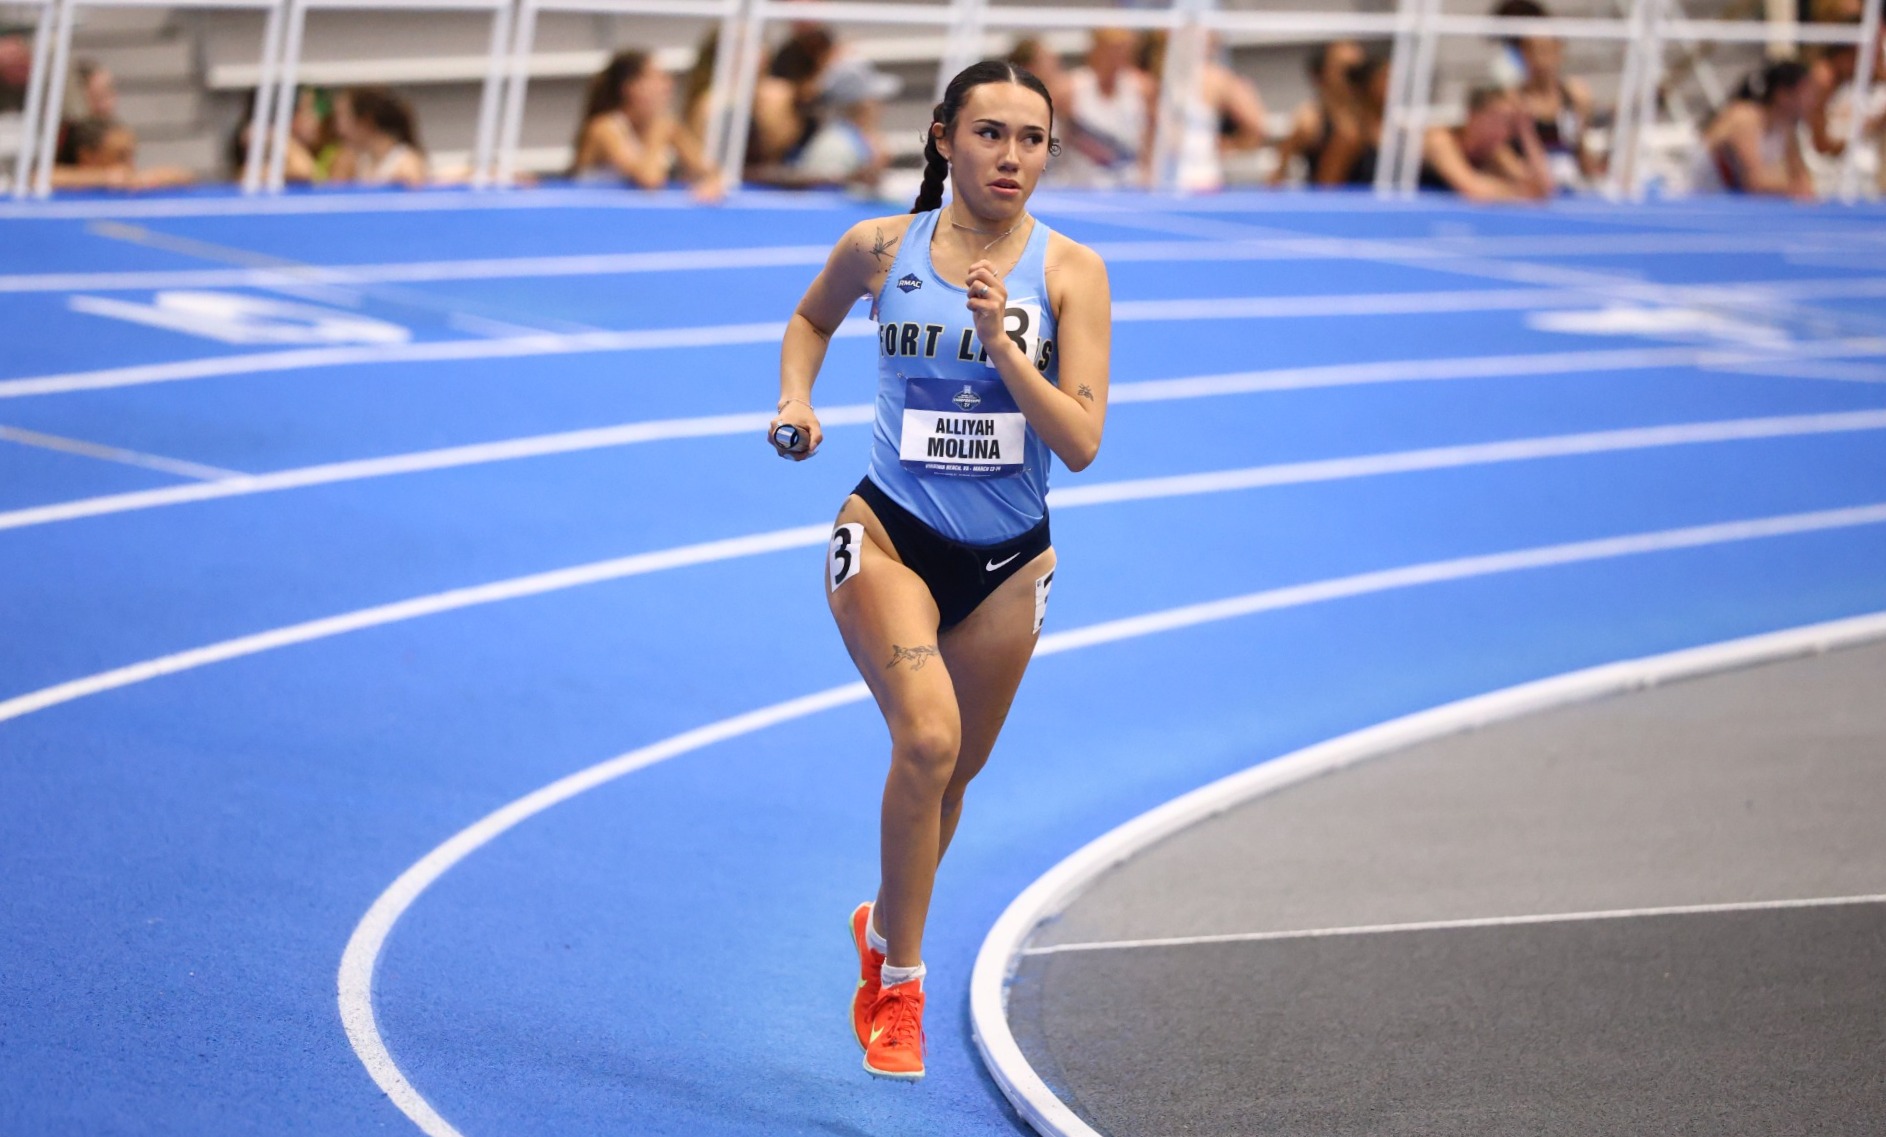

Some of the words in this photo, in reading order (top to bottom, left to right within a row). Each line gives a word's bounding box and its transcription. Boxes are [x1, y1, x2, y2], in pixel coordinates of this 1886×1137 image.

[899, 279, 921, 288] RMAC
[935, 417, 995, 436] ALLIYAH
[926, 436, 1001, 460] MOLINA
[833, 527, 852, 586] 3
